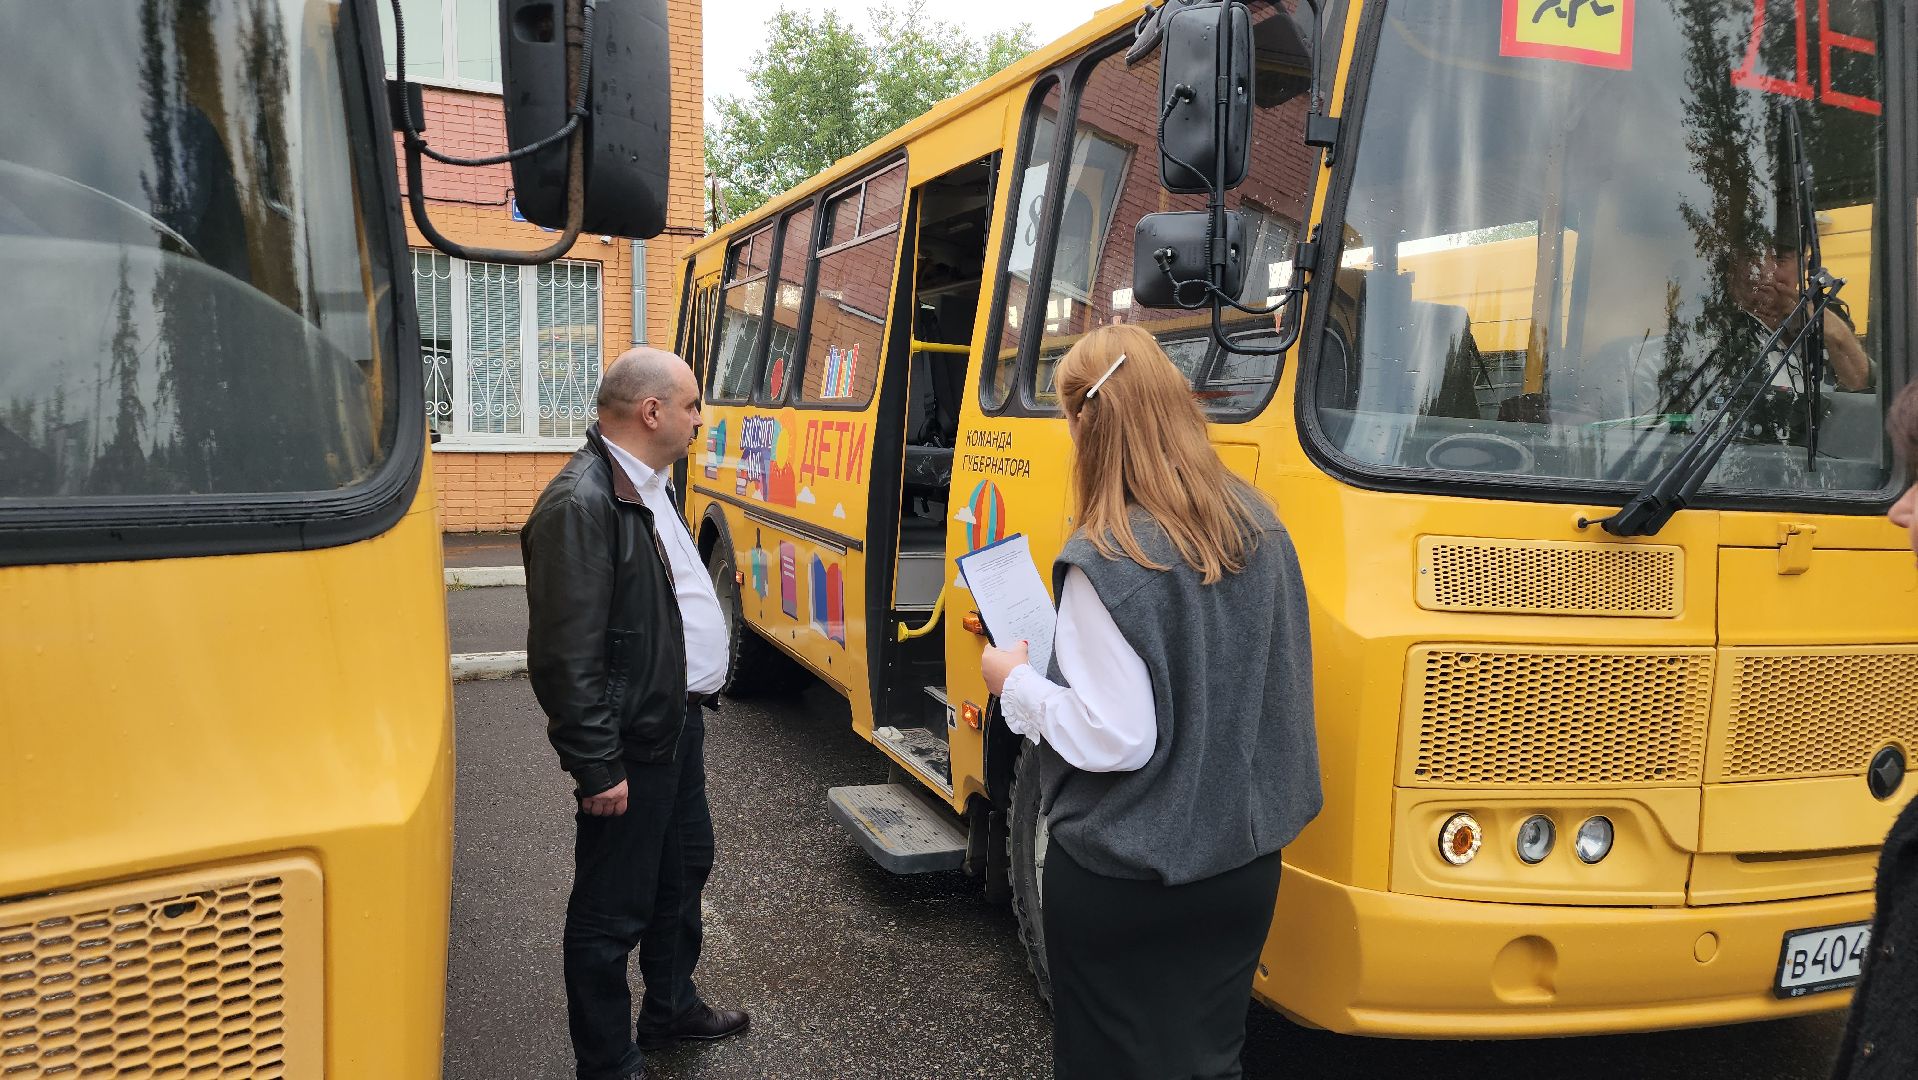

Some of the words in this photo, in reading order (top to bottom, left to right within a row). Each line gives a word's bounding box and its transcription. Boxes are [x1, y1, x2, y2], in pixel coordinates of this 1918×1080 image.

[799, 419, 868, 487] ДЕТИ
[965, 429, 1012, 452] КОМАНДА
[962, 454, 1030, 479] ГУБЕРНАТОРА
